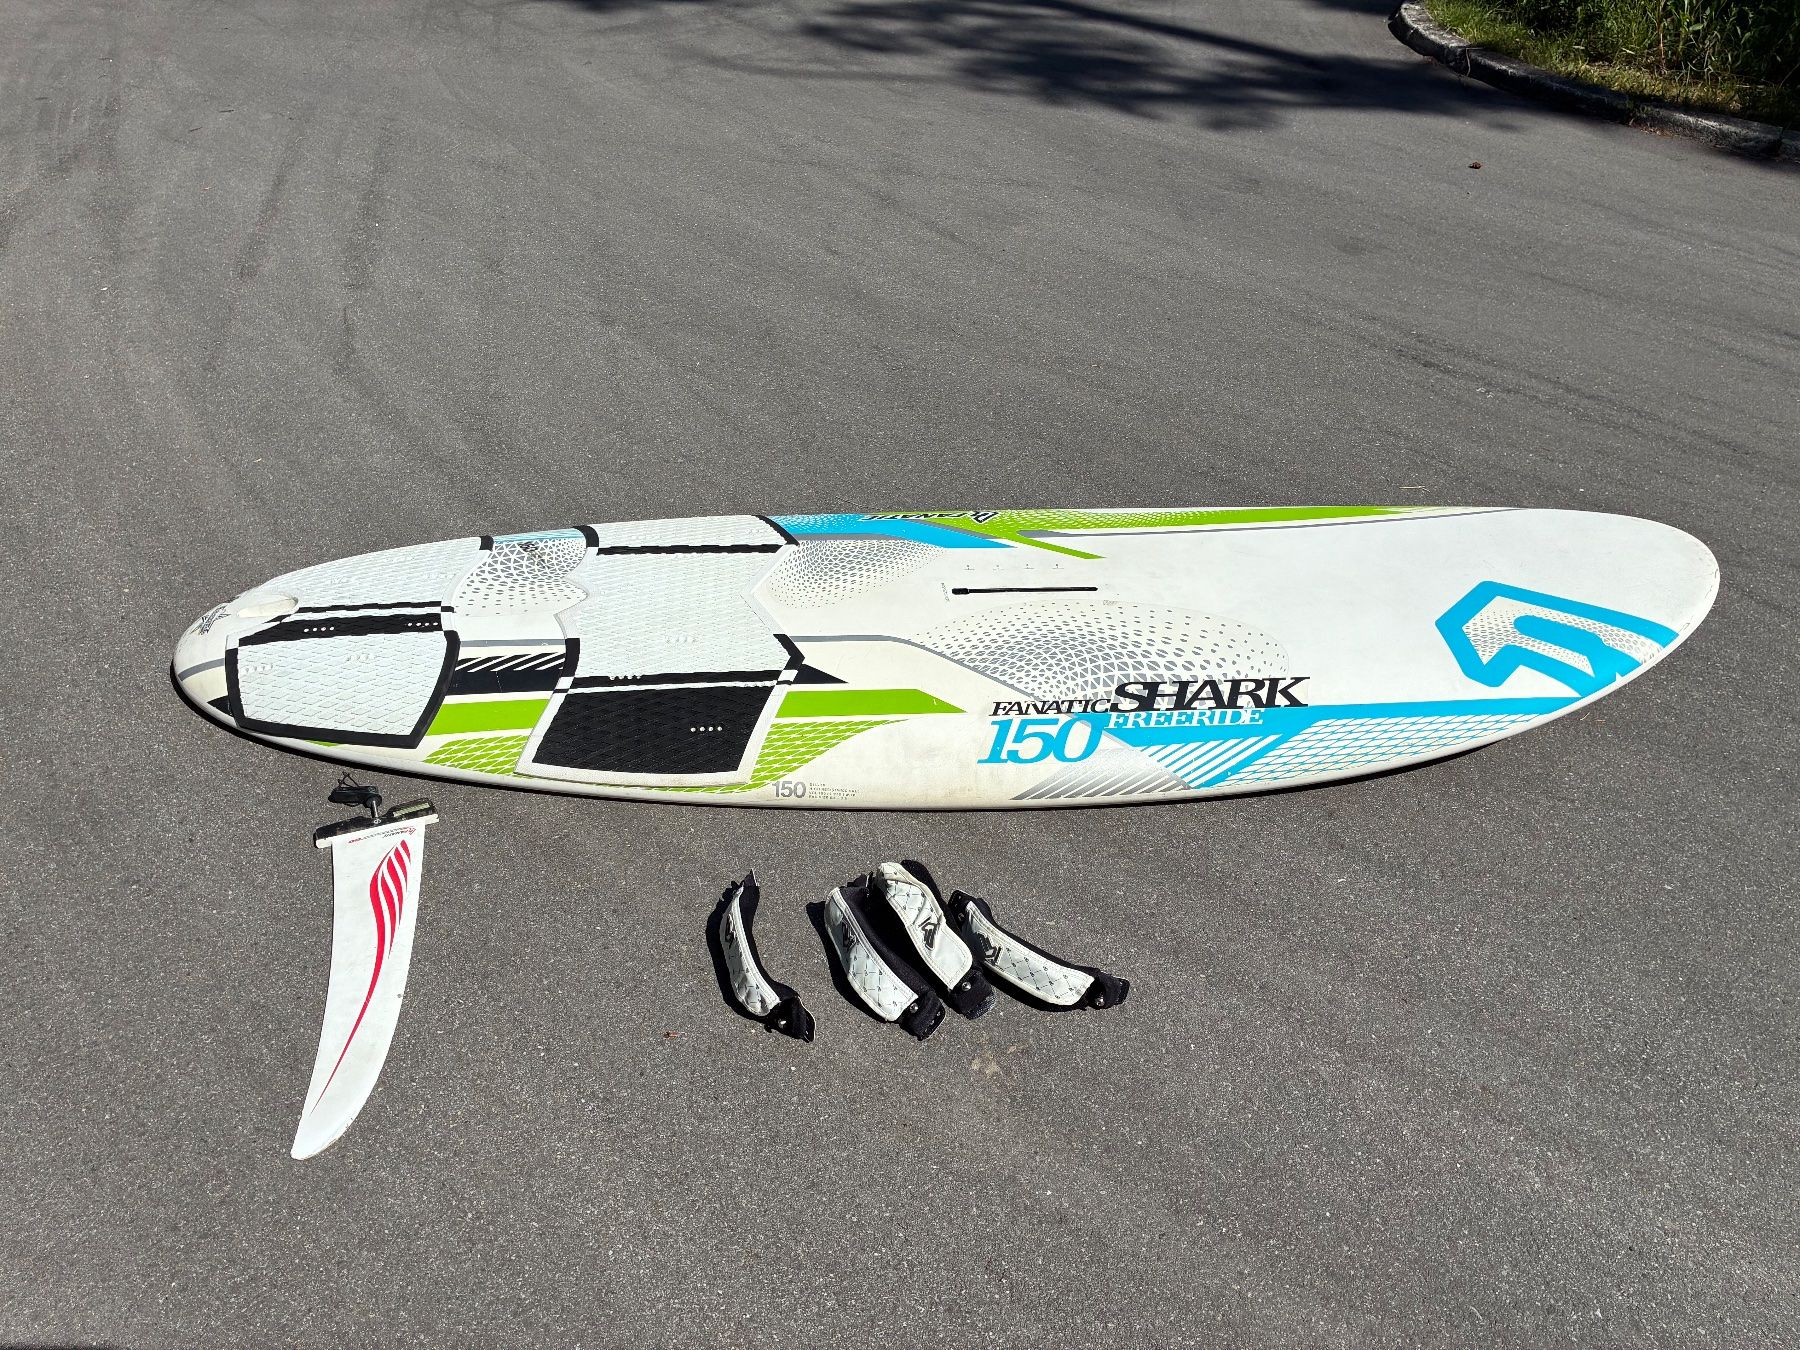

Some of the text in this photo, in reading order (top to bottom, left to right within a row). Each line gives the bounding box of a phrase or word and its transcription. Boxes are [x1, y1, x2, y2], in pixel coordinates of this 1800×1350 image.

[988, 676, 1311, 717] FANATIC SHARK
[977, 708, 1265, 765] 150 FREERIDE
[772, 781, 807, 799] 150
